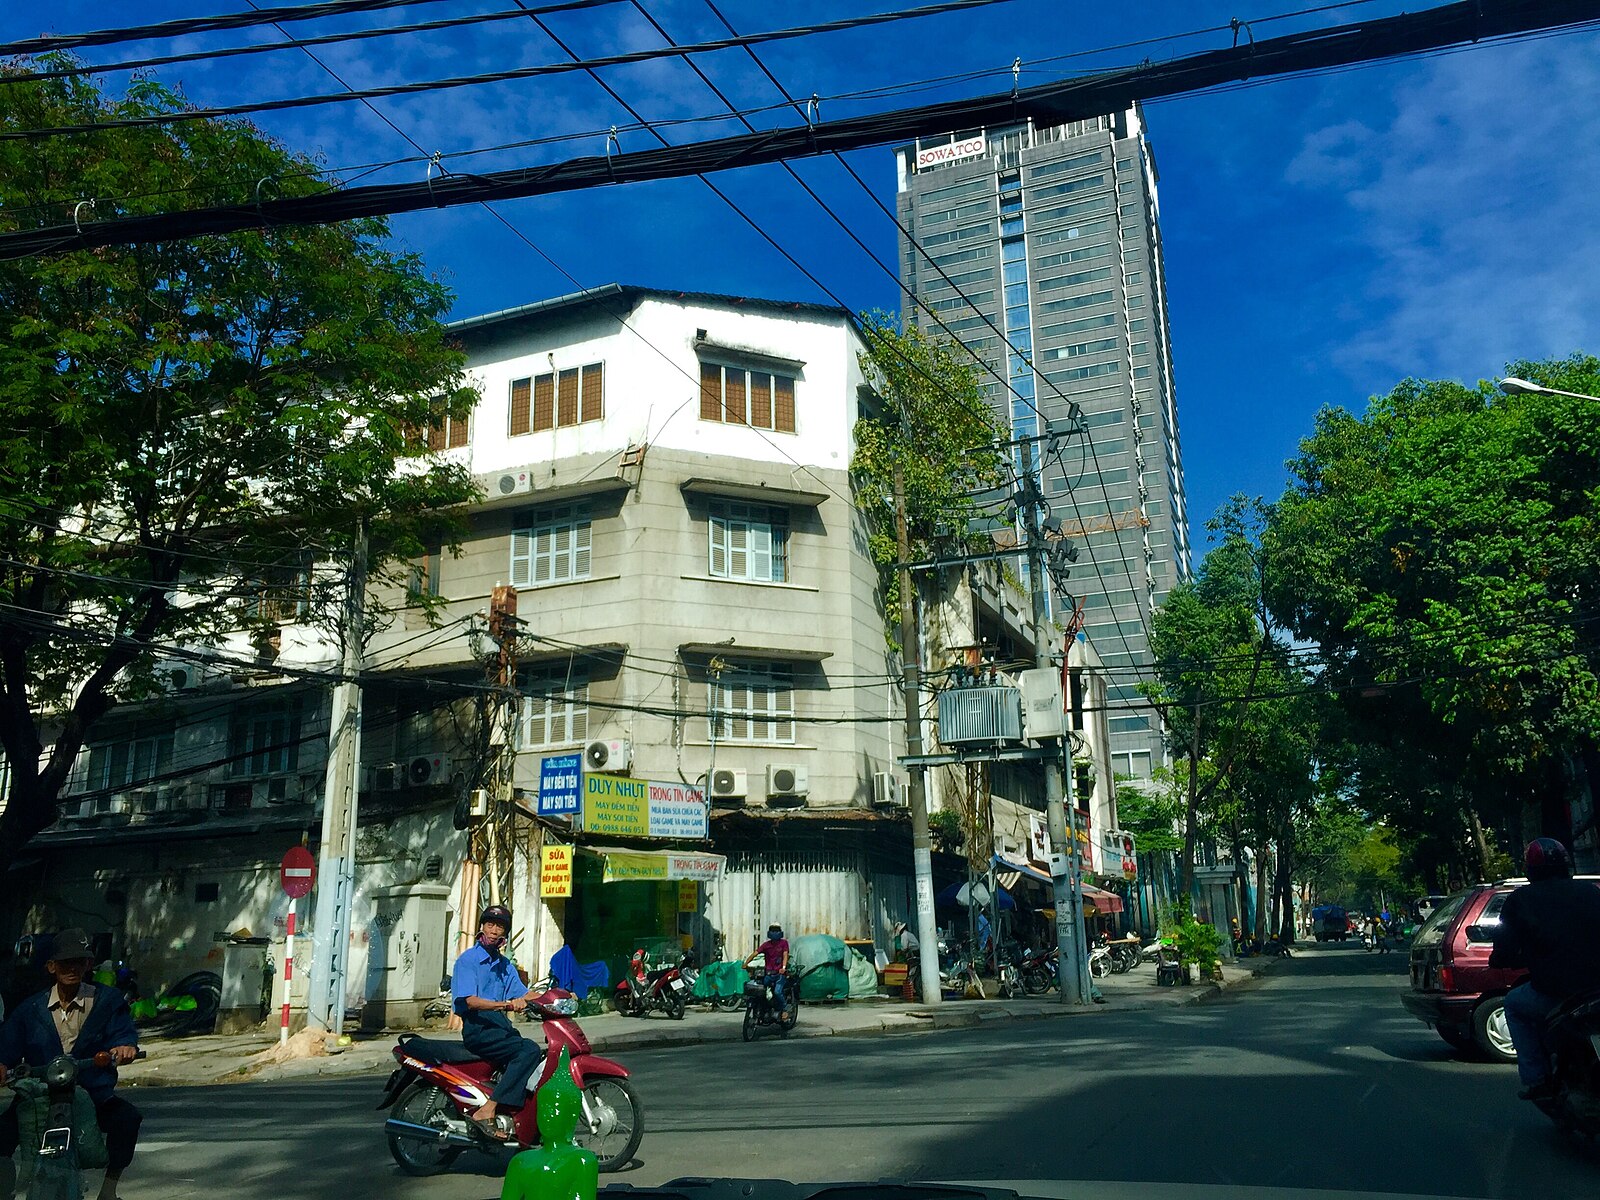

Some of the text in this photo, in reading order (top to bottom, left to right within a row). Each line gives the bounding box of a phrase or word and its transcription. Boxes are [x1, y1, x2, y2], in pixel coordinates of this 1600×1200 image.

[920, 141, 982, 164] SOWATCO
[590, 778, 644, 801] DUY NHỤT
[649, 787, 671, 803] TRỌNG
[685, 789, 703, 802] GAME
[550, 848, 564, 860] SỬA
